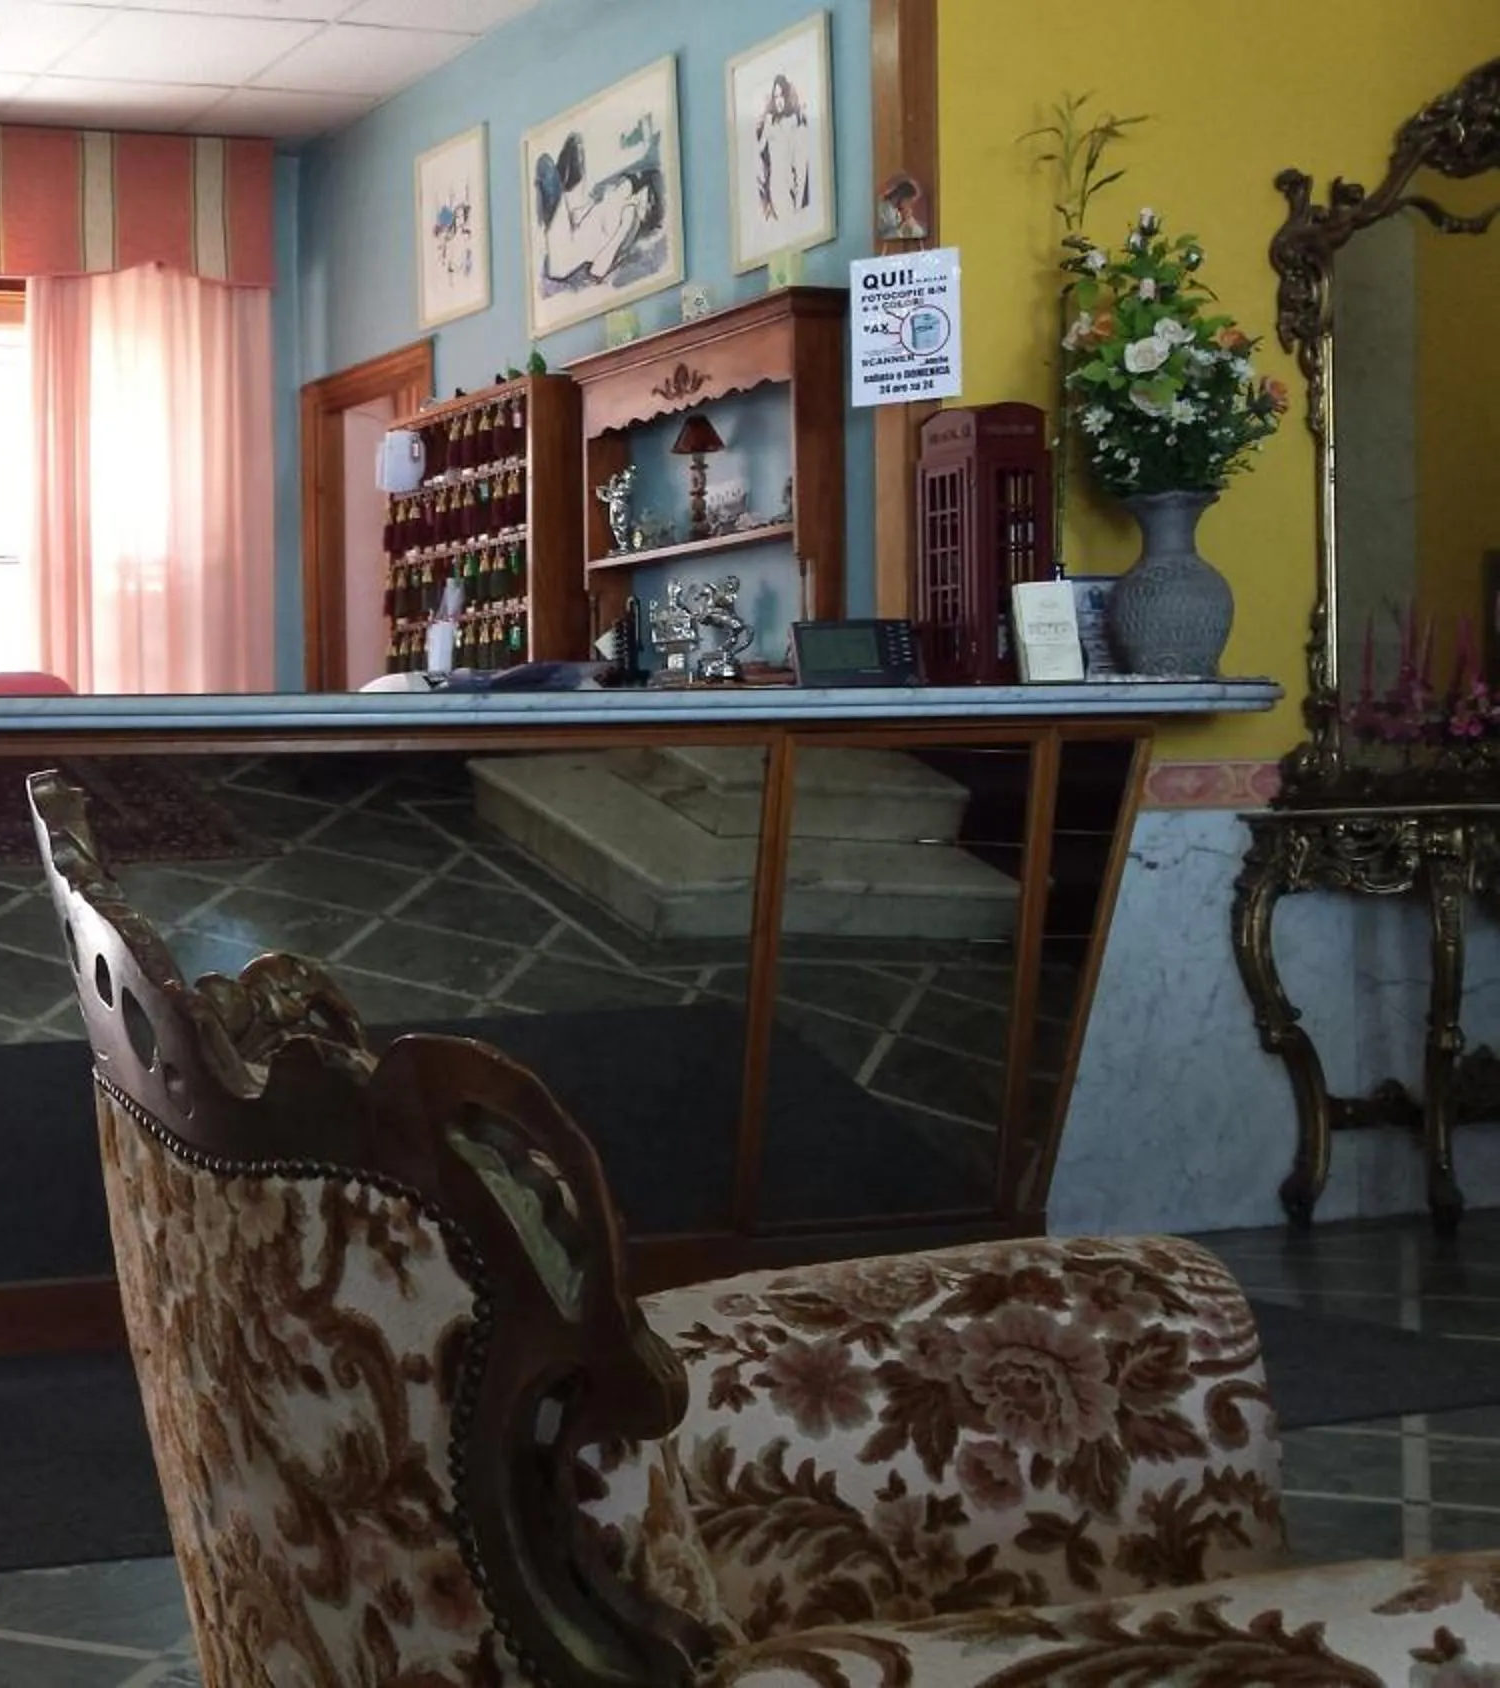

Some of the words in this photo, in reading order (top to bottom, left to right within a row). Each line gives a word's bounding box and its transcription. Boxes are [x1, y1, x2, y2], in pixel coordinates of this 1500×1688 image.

[862, 269, 914, 290] QUI!
[861, 287, 925, 303] FOTOCOPIE
[881, 298, 925, 310] COLORI
[863, 322, 889, 335] FAX
[861, 354, 915, 367] SCANNER
[863, 373, 895, 383] sabato
[903, 365, 951, 379] DOMENICA
[879, 383, 891, 395] 24
[892, 383, 908, 393] ore
[910, 382, 921, 391] su
[922, 379, 934, 391] 24
